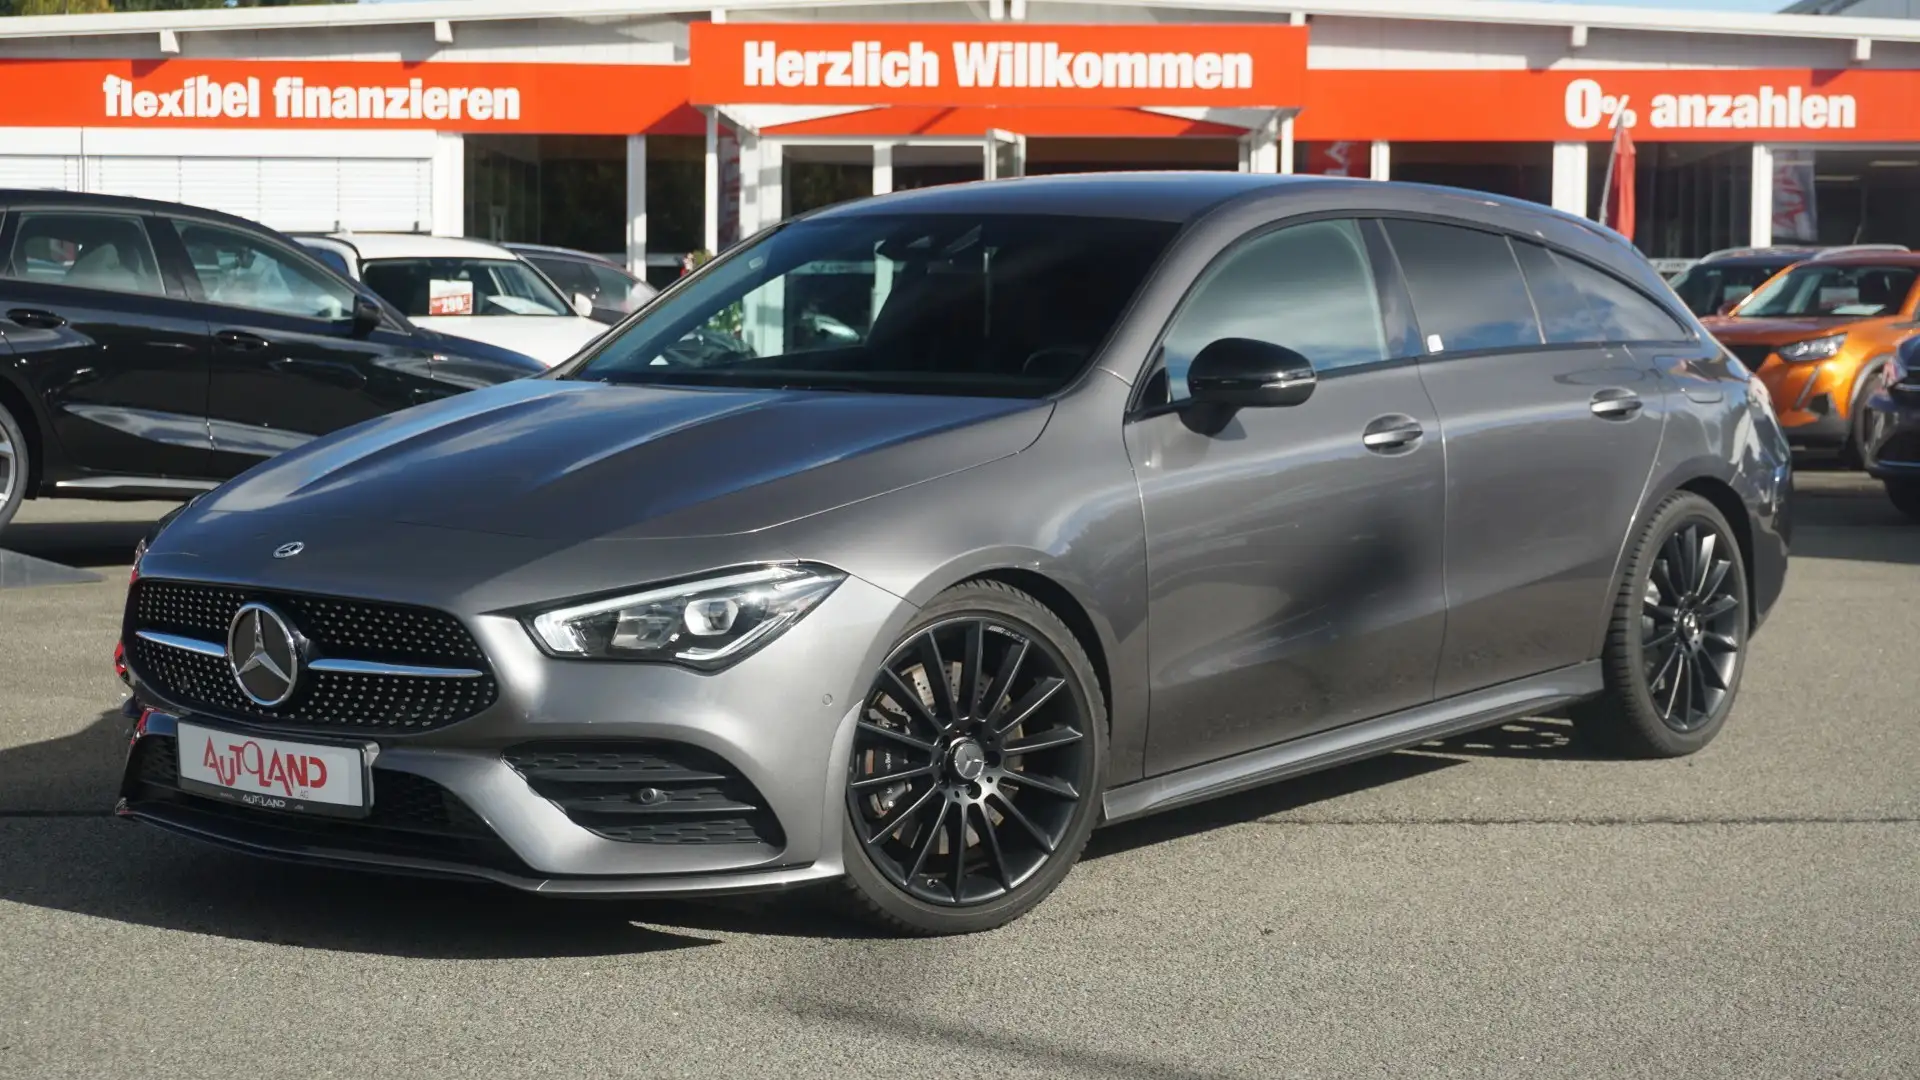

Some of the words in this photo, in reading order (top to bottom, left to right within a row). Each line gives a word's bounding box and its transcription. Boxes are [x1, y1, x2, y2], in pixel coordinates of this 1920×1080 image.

[743, 41, 939, 88] Herzlich
[953, 42, 1253, 89] Willkommen
[103, 74, 260, 118] flexibel
[273, 77, 520, 120] finanzieren
[1564, 79, 1637, 129] 0%
[1650, 86, 1856, 129] anzahlen
[203, 736, 327, 795] AUTOLAND
[242, 794, 286, 808] AUTOLAND
